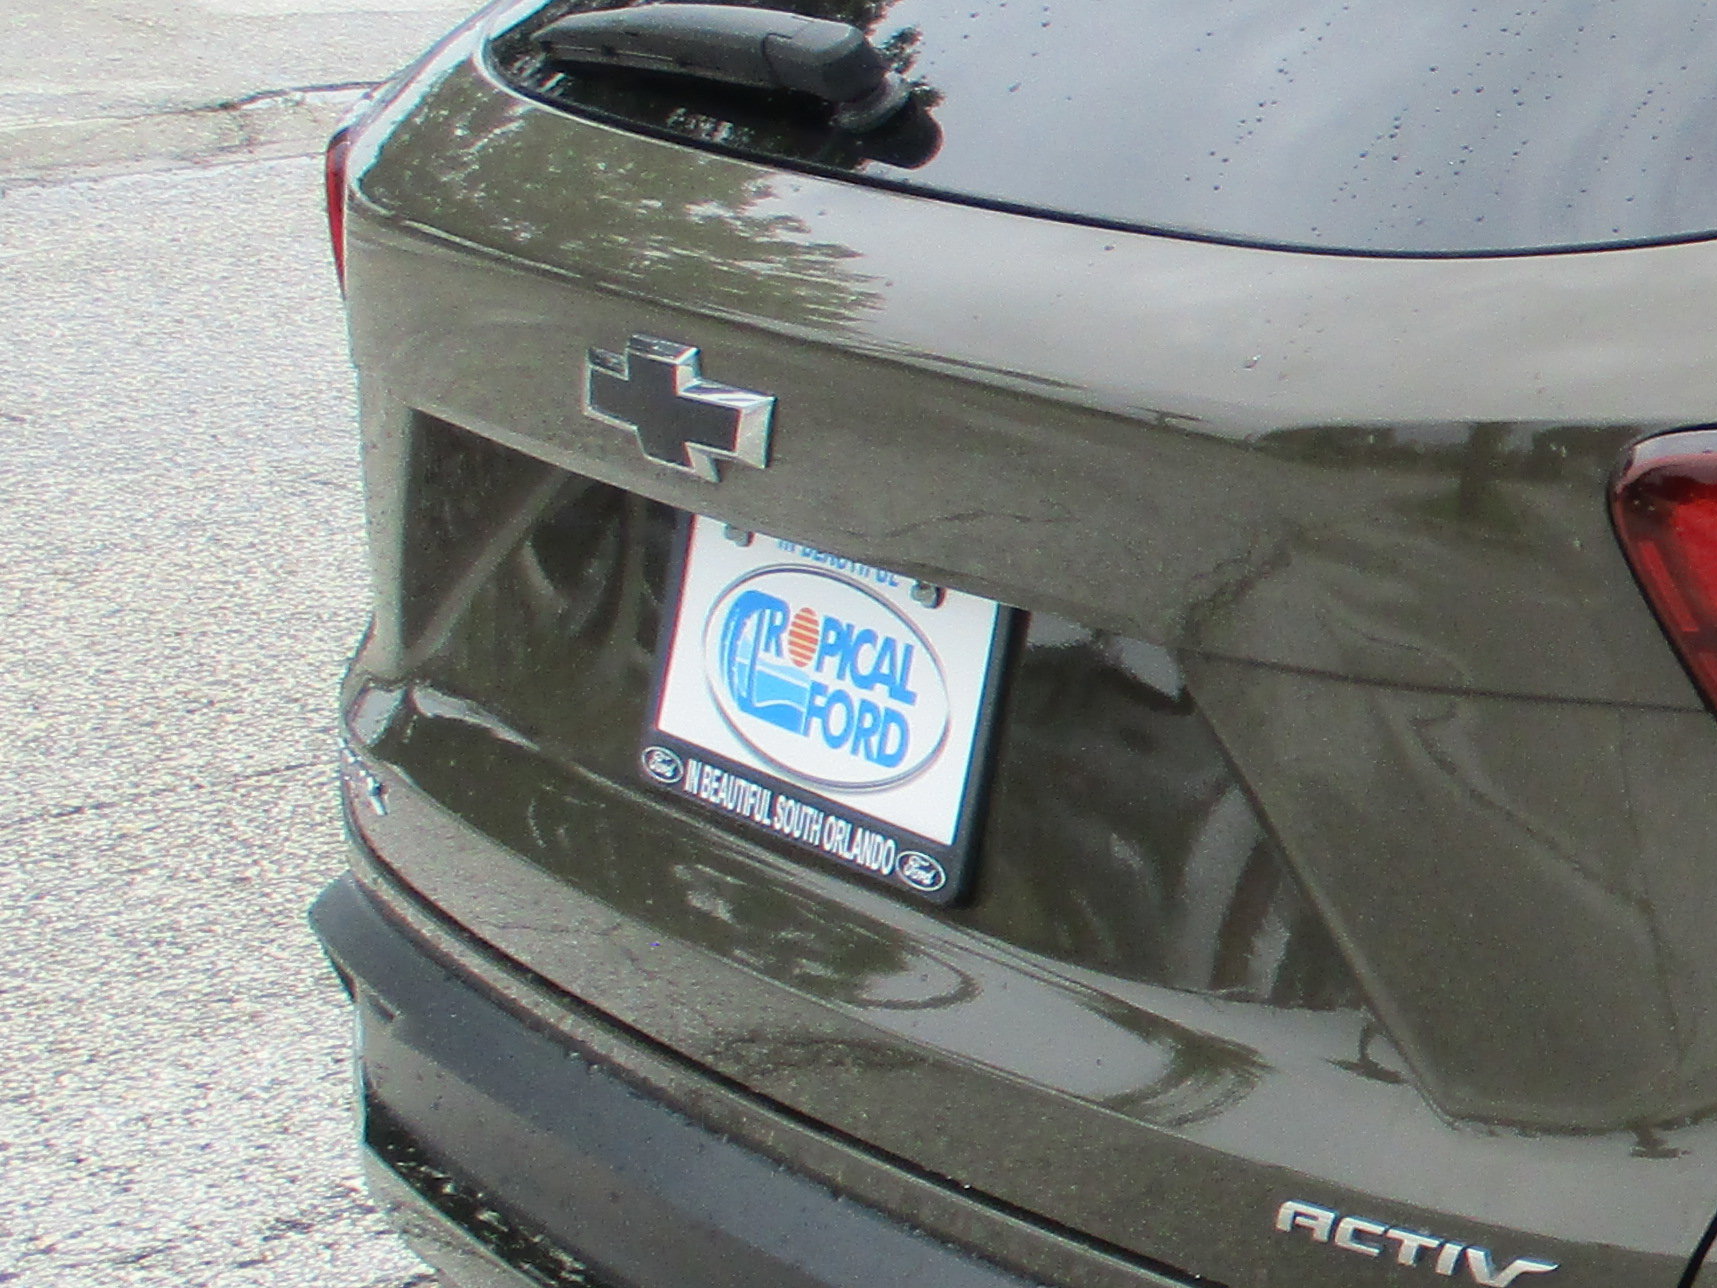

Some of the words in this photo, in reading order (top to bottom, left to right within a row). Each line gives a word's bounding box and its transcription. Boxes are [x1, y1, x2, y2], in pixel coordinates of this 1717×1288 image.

[720, 590, 918, 707] TROPICAL
[802, 679, 910, 768] FORD
[684, 759, 702, 794] IN
[701, 765, 772, 827] BEAUTIFUL
[773, 795, 825, 846] SOUTH
[822, 815, 896, 875] ORLANDO
[1275, 1199, 1560, 1288] ACTIV
